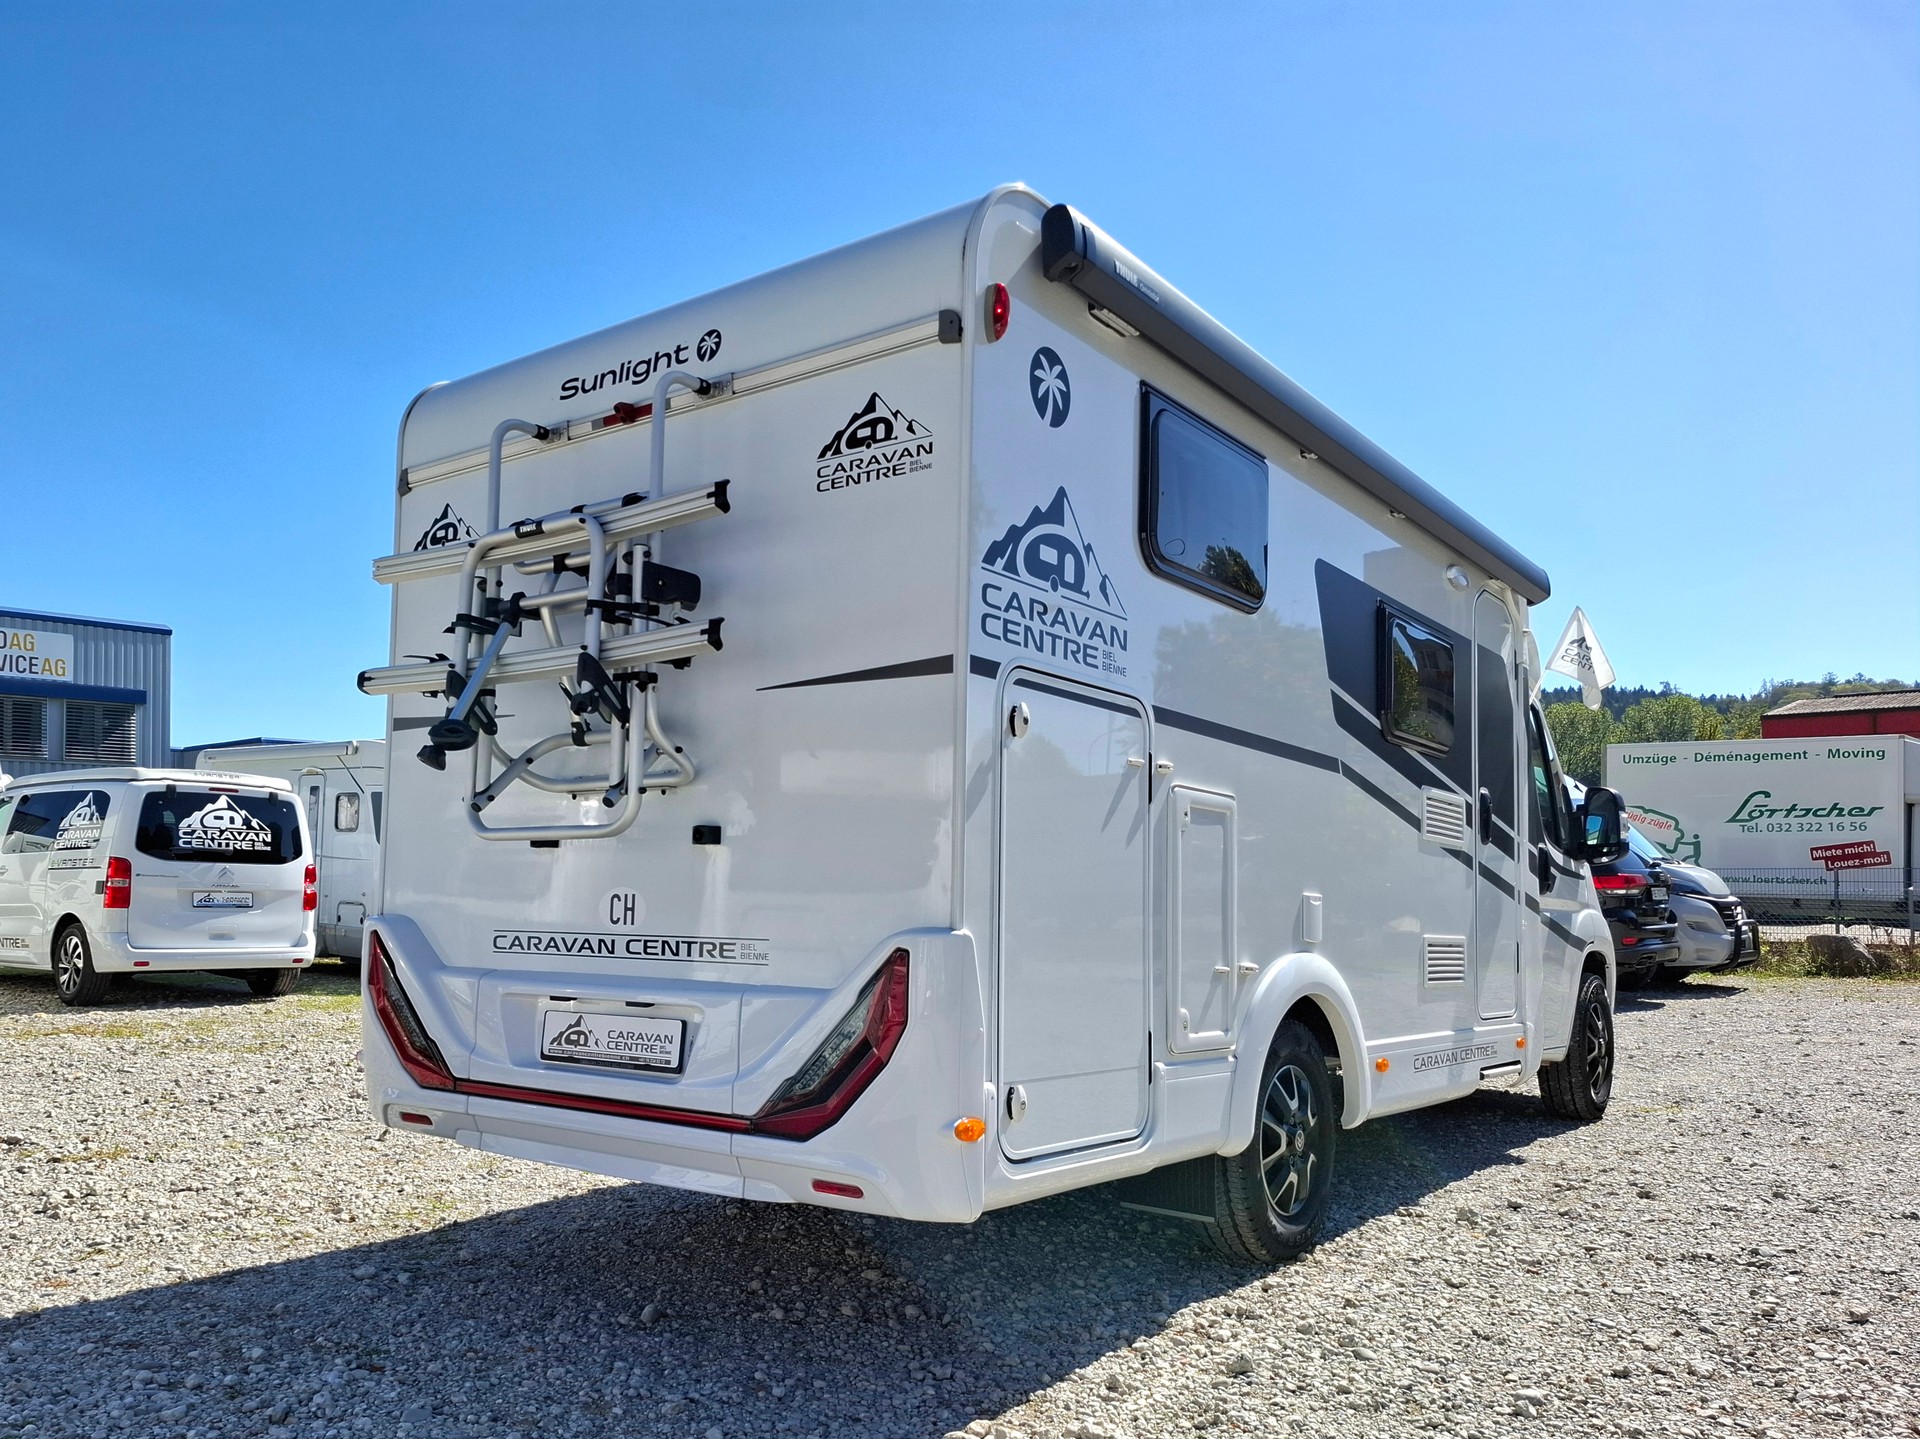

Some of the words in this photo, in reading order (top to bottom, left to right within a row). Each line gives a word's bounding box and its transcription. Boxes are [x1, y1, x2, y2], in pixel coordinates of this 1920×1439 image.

[559, 344, 689, 400] Sunlight
[817, 441, 933, 478] CARAVAN
[909, 459, 923, 467] BIEL
[909, 463, 933, 473] BIENNE
[816, 462, 907, 492] CENTRE
[981, 582, 1128, 652] CARAVAN
[980, 612, 1099, 670] CENTRE
[1102, 650, 1117, 664] BIEL
[1561, 654, 1595, 674] CENT
[1101, 663, 1127, 677] BIENNE
[1622, 753, 1677, 766] Umzüge
[1694, 749, 1808, 764] Déménagement
[1827, 747, 1886, 761] Moving
[1625, 811, 1647, 824] ügig
[56, 828, 101, 840] CARAVAN
[1739, 823, 1763, 833] Tel.
[1766, 823, 1793, 833] 032
[1796, 822, 1823, 832] 322
[1828, 822, 1845, 832] 16
[1848, 821, 1868, 832] 56
[178, 829, 272, 842] CARAVAN
[53, 838, 88, 849] CENTRE
[178, 838, 254, 850] CENTRE
[1812, 848, 1842, 859] Miete
[1846, 843, 1875, 855] mich!
[1828, 854, 1888, 869] Louez-moi!
[609, 893, 636, 926] CH
[493, 935, 615, 956] CARAVAN
[625, 938, 737, 960] CENTRE
[740, 943, 757, 952] BIEL
[740, 952, 769, 961] BIENNE
[607, 1029, 674, 1045] CARAVAN
[606, 1040, 659, 1054] CENTRE
[1413, 1051, 1458, 1070] CARAVAN
[1460, 1045, 1491, 1061] CENTRE
